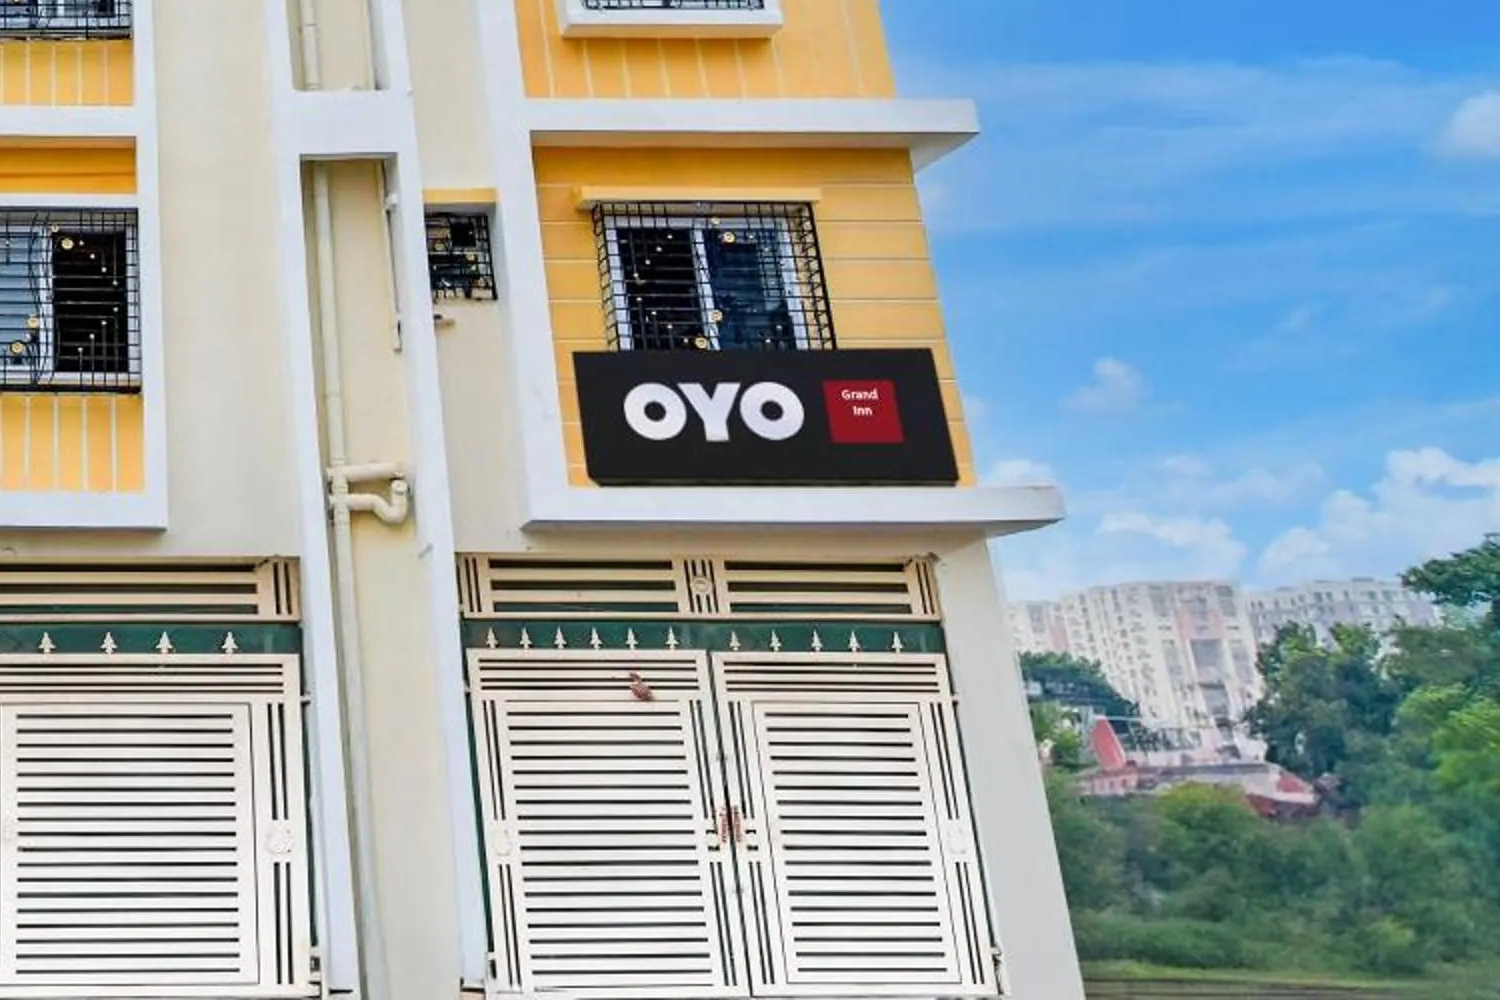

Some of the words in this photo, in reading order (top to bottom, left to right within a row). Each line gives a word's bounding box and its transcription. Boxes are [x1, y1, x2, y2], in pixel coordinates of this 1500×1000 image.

[841, 388, 879, 400] Grand
[623, 381, 805, 442] OYO
[853, 405, 873, 416] Inn
